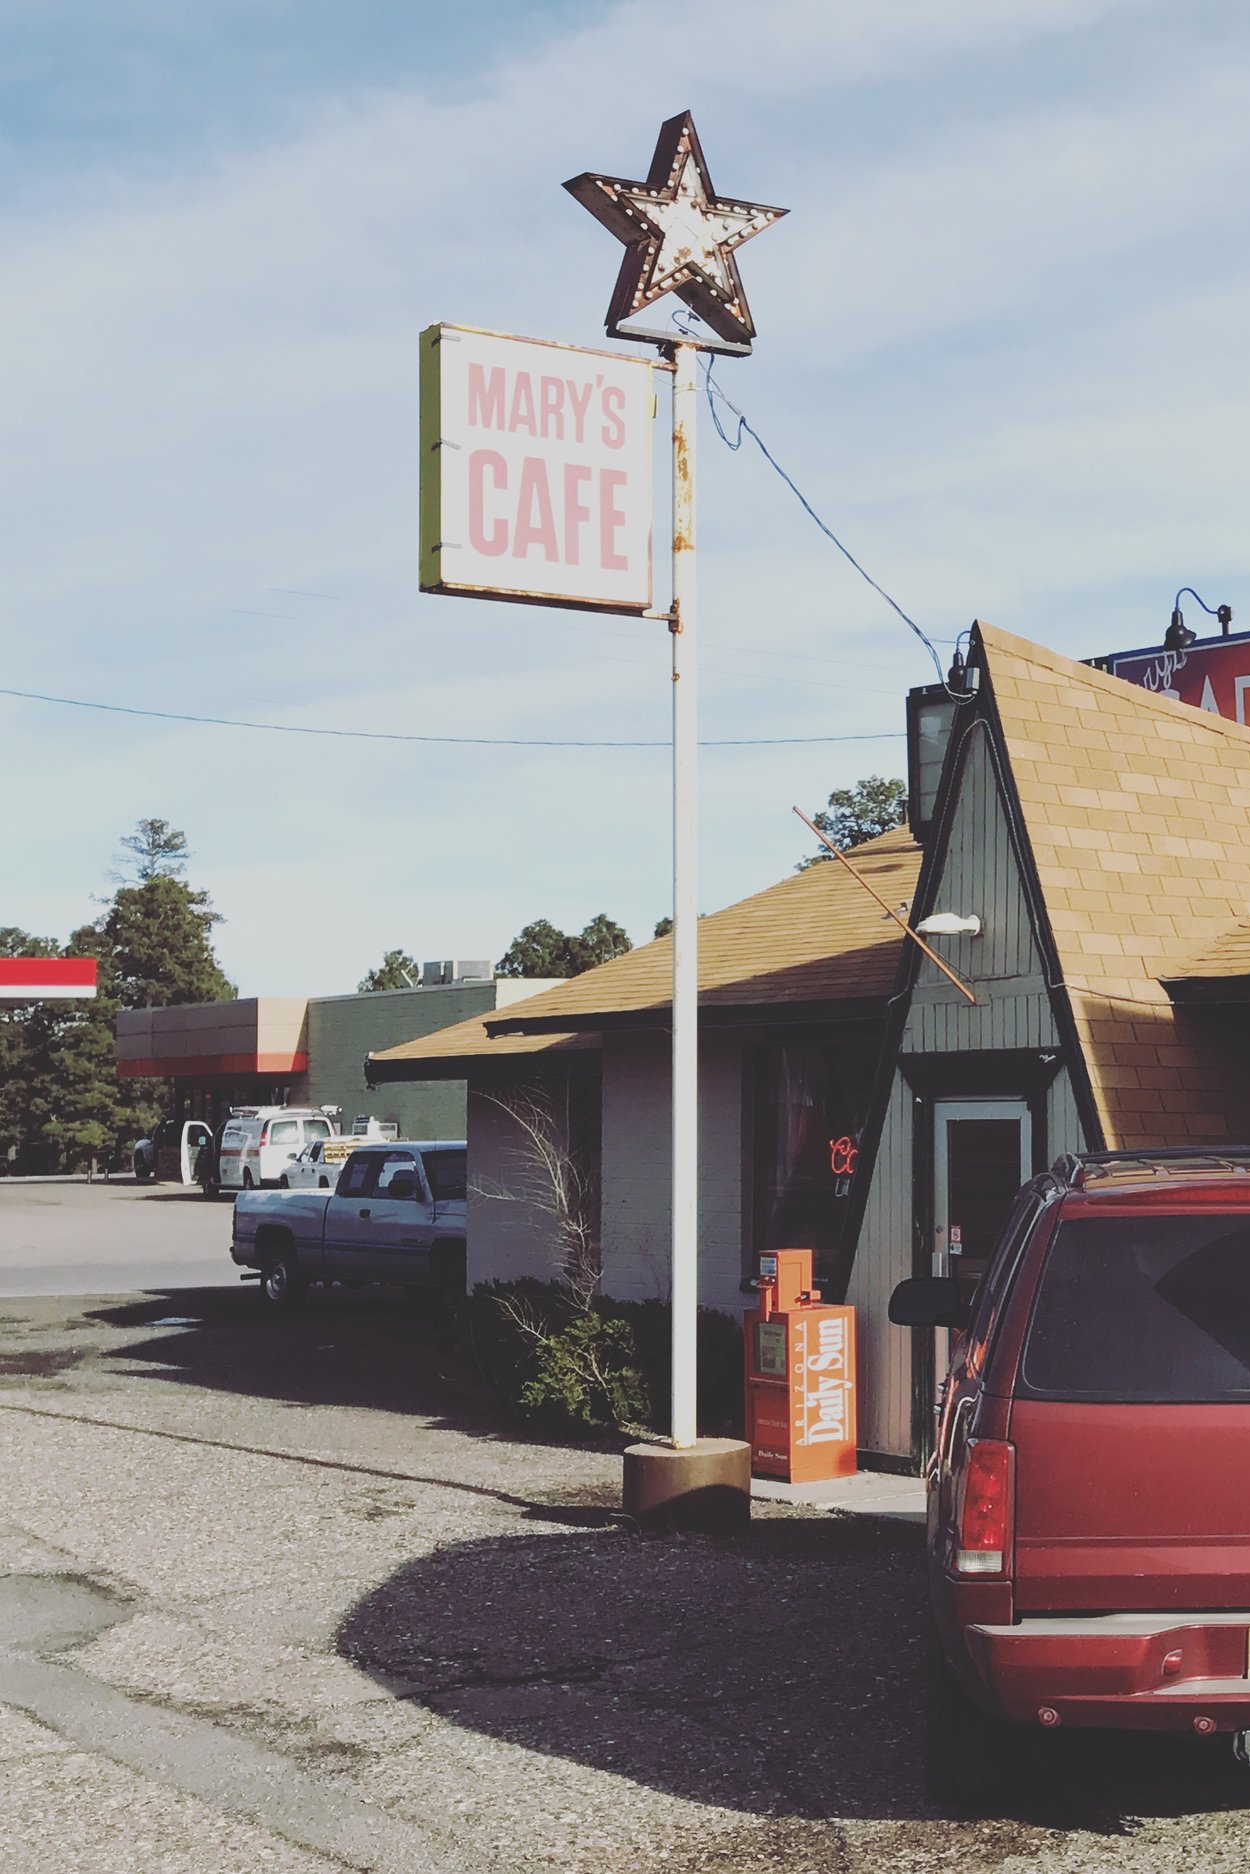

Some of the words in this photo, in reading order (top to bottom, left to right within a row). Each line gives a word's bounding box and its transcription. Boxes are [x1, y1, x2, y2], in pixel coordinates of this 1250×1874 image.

[467, 362, 626, 450] MARY'S
[467, 448, 629, 572] CAFE
[794, 1321, 806, 1446] ARIZONA
[807, 1317, 843, 1372] Sun
[807, 1376, 853, 1446] Daily
